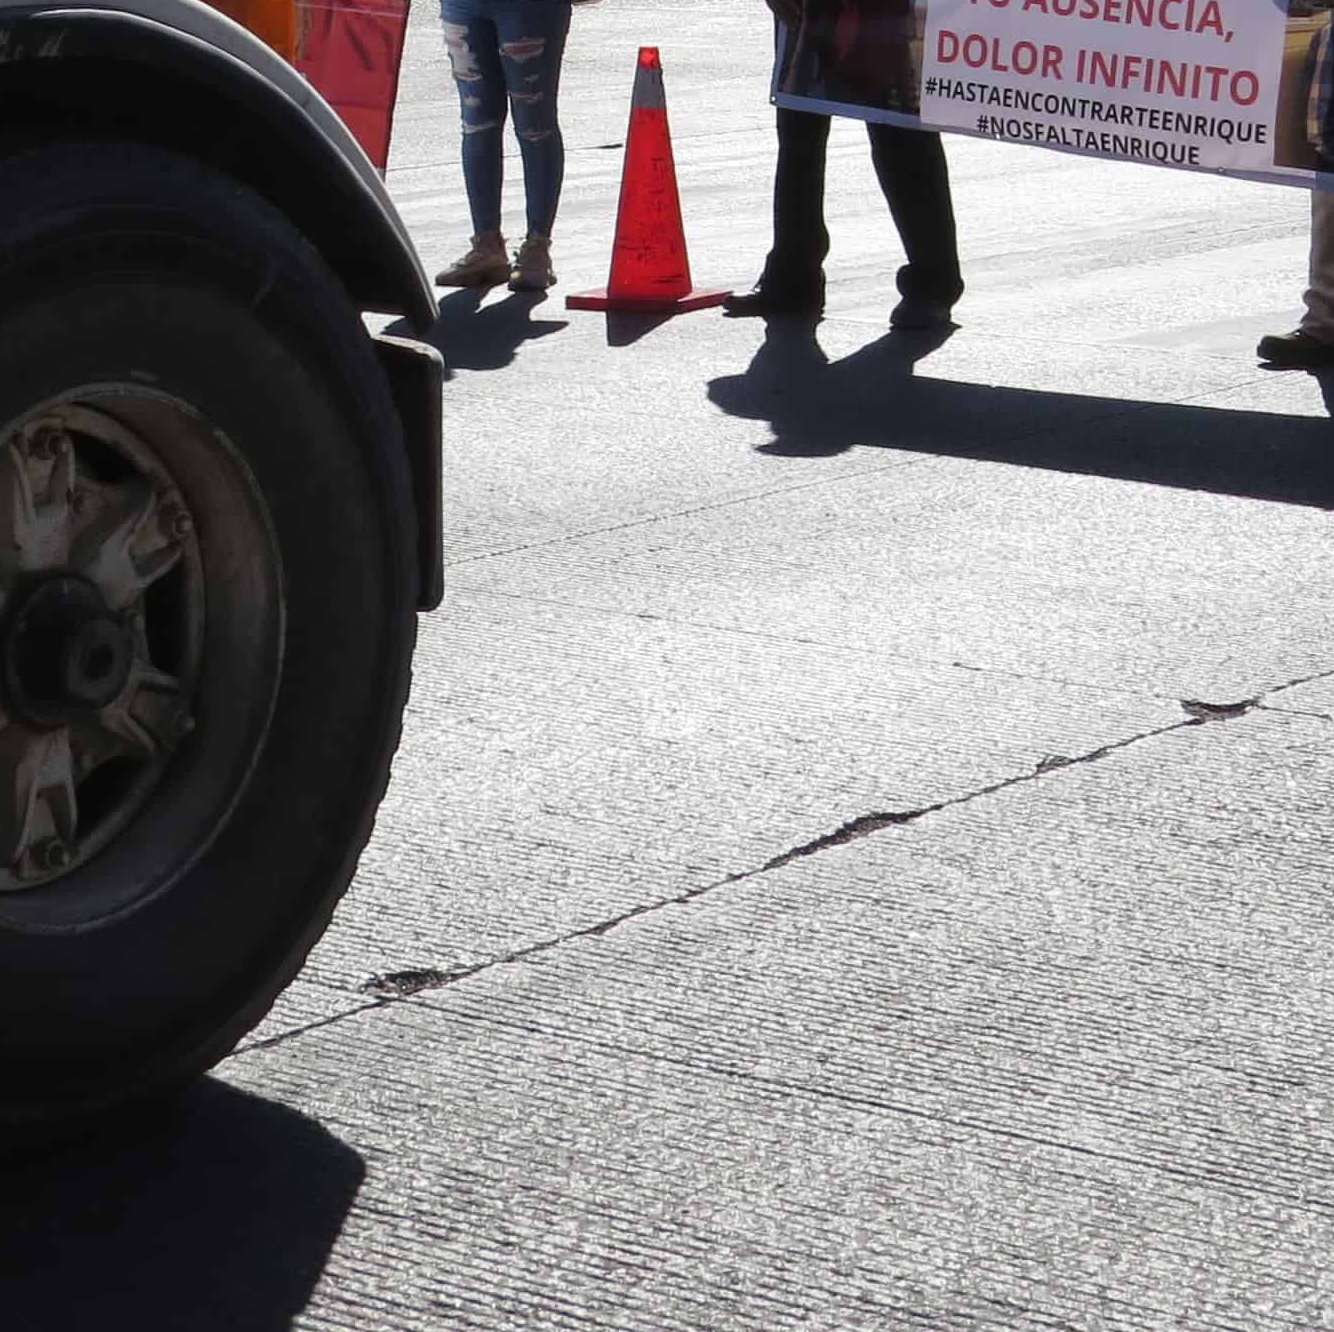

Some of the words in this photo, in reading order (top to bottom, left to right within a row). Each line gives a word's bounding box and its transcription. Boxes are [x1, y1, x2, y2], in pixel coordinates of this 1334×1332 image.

[937, 30, 1064, 81] DOLOR
[1076, 49, 1260, 106] INFINITO
[924, 76, 1267, 145] #HASTAENCONTRARTEENRIQUE
[976, 115, 1201, 165] #NOSFALTAENRIQUE
